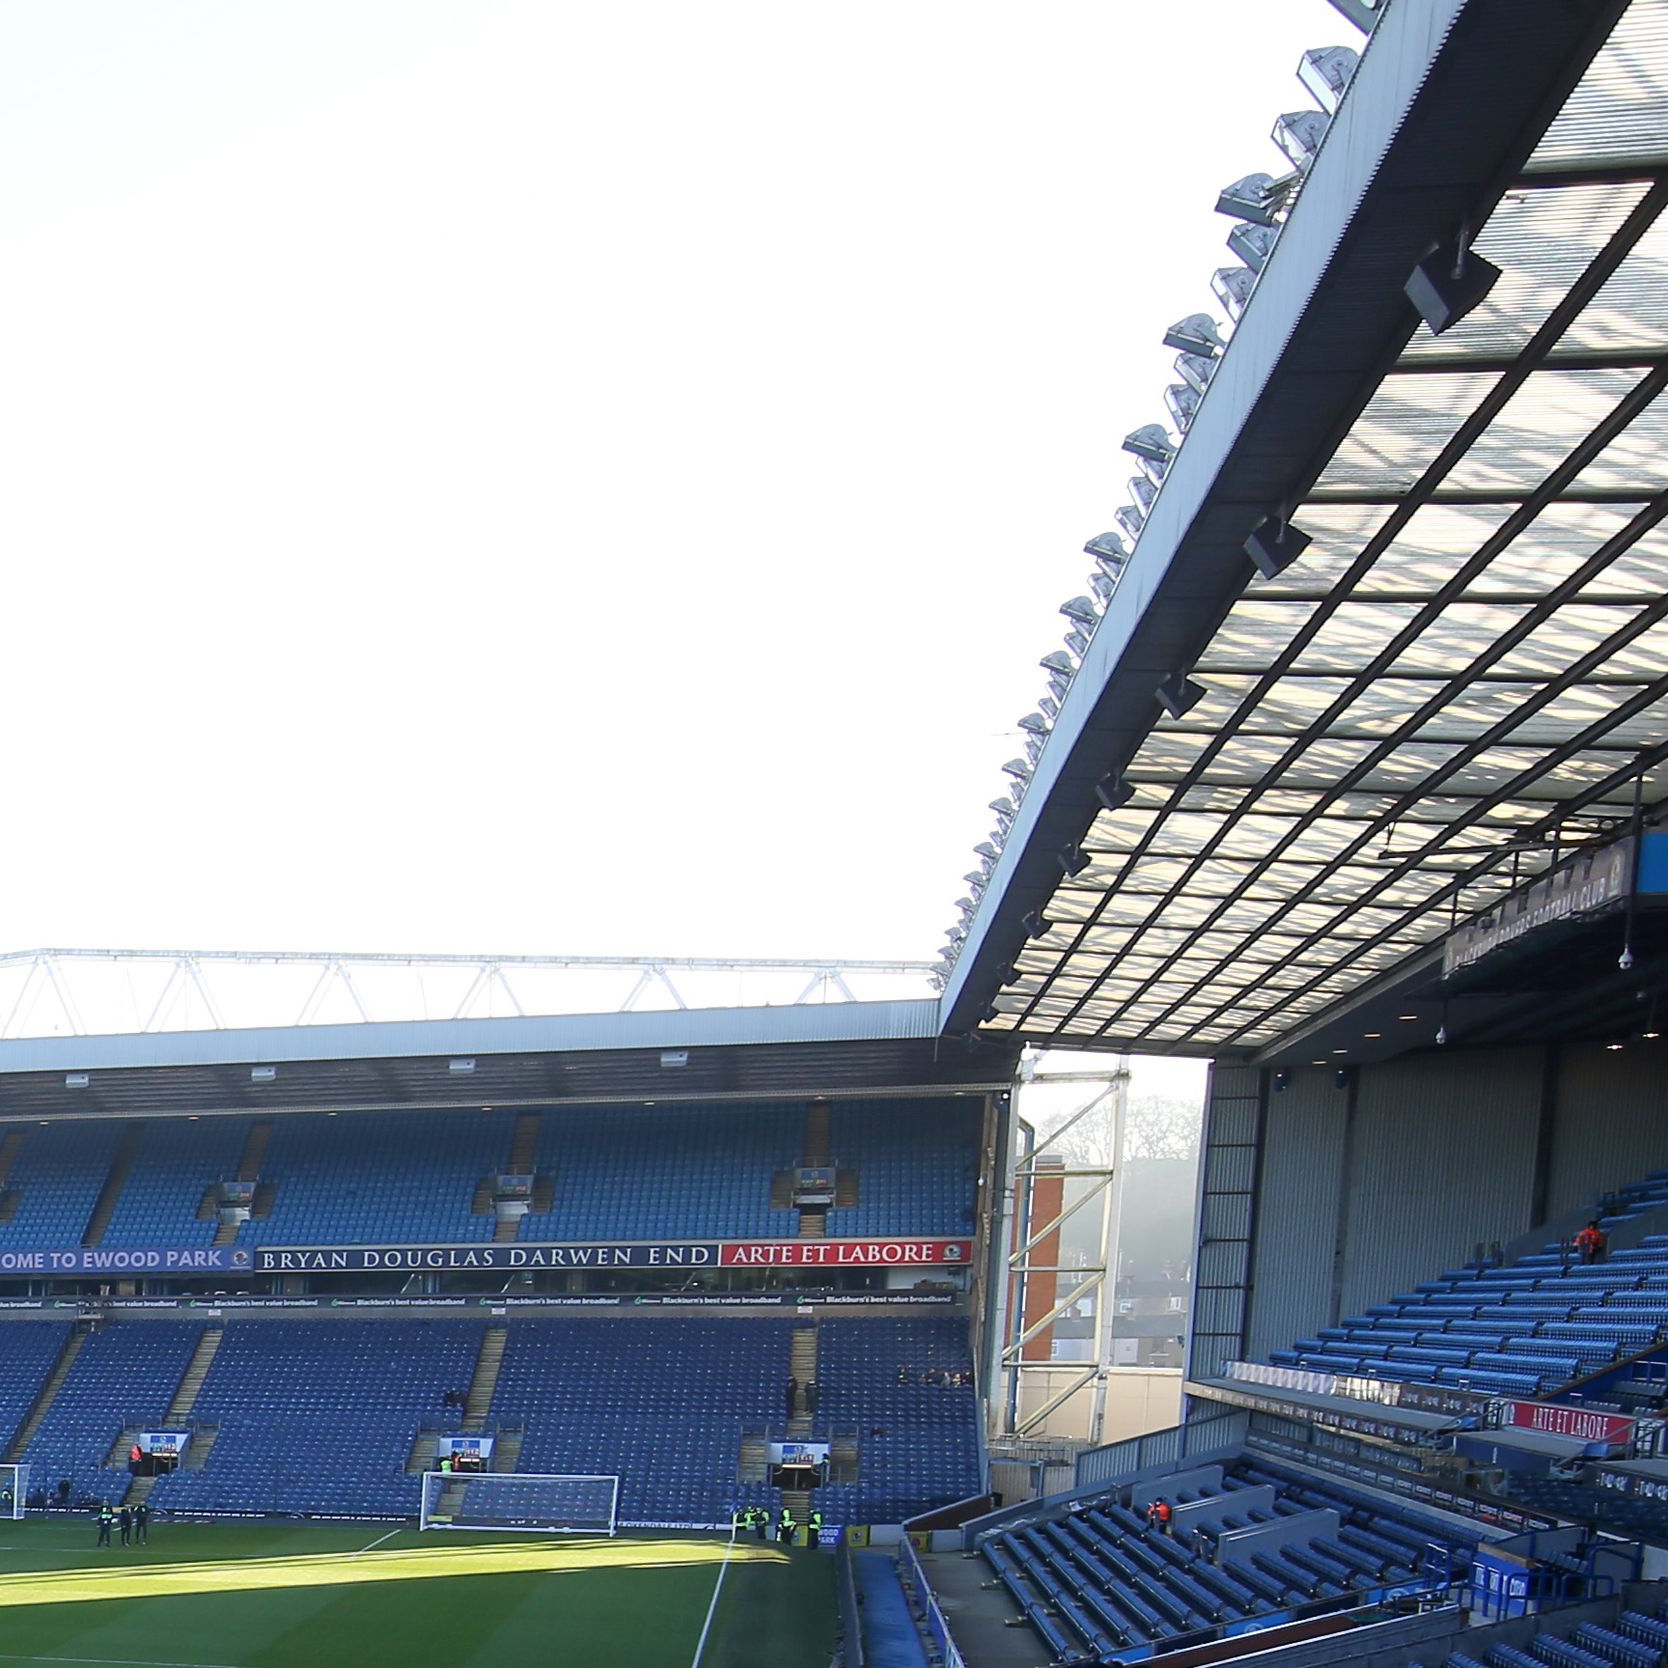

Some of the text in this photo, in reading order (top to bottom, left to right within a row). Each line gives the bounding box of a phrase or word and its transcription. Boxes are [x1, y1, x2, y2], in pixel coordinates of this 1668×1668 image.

[1581, 877, 1606, 913] CLUB
[49, 1252, 77, 1268] TO
[83, 1252, 160, 1268] EWOOD
[166, 1250, 223, 1266] PARK
[263, 1246, 710, 1269] BRYAN DOUGLAS DARWEN END
[731, 1244, 914, 1263] ARTE ET LABORE
[506, 1297, 545, 1305] Blackburn's
[582, 1297, 620, 1305] broadband
[1531, 1407, 1609, 1441] ARTE ET LABORE
